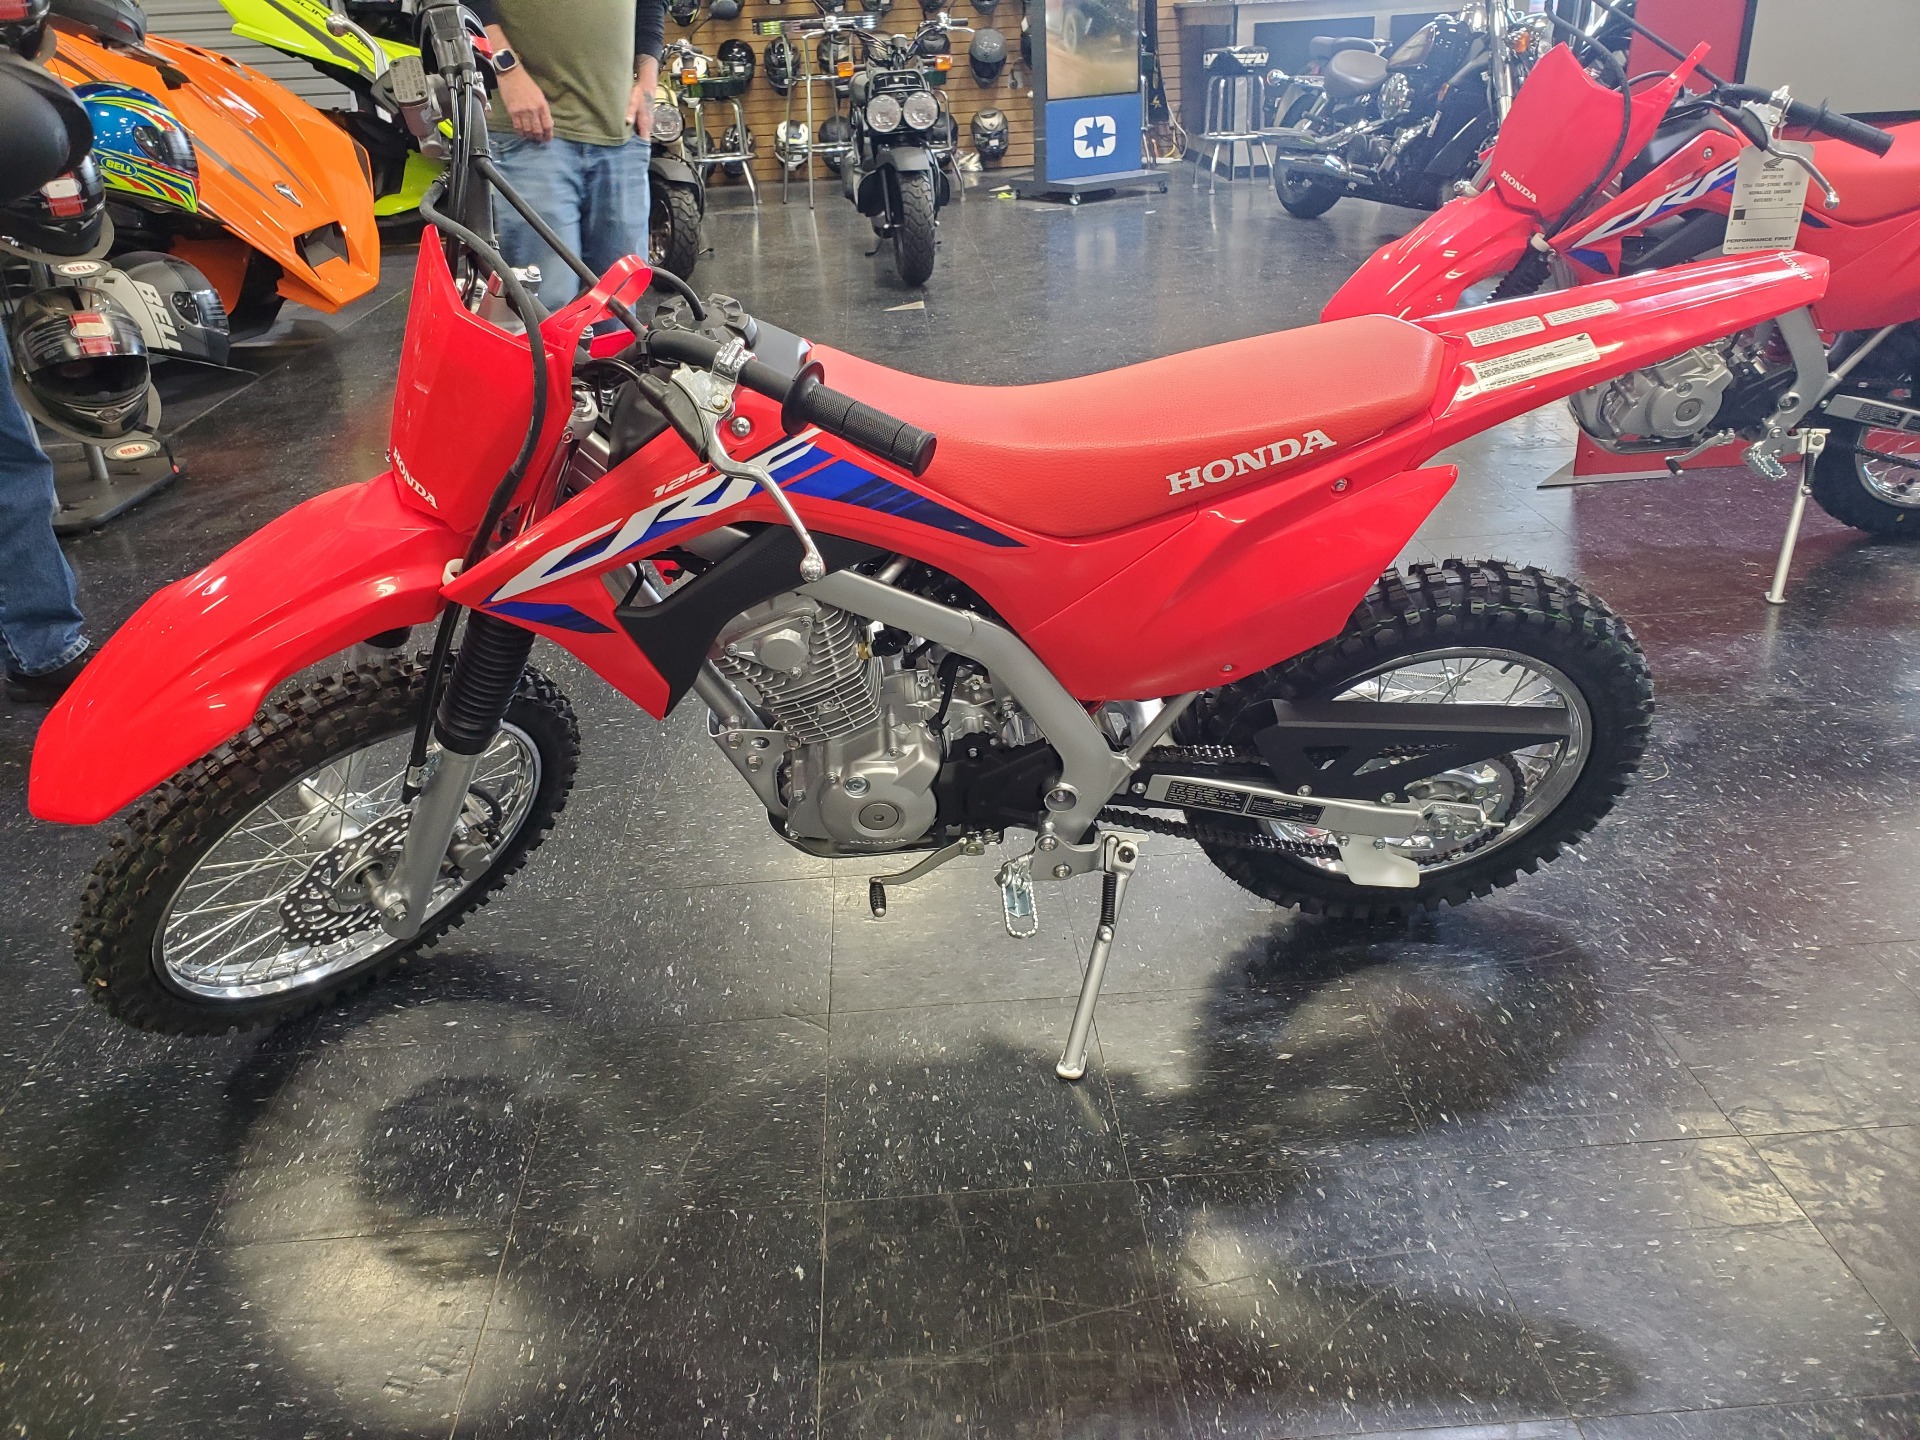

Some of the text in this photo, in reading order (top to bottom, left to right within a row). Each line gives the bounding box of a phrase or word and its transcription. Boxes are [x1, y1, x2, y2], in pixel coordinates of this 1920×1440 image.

[105, 159, 132, 175] BELL
[1500, 169, 1537, 204] HONDA
[67, 264, 96, 273] BELL
[131, 280, 183, 352] BELL
[120, 445, 146, 455] BELL
[1165, 429, 1338, 496] HONDA
[393, 445, 439, 510] HONDA
